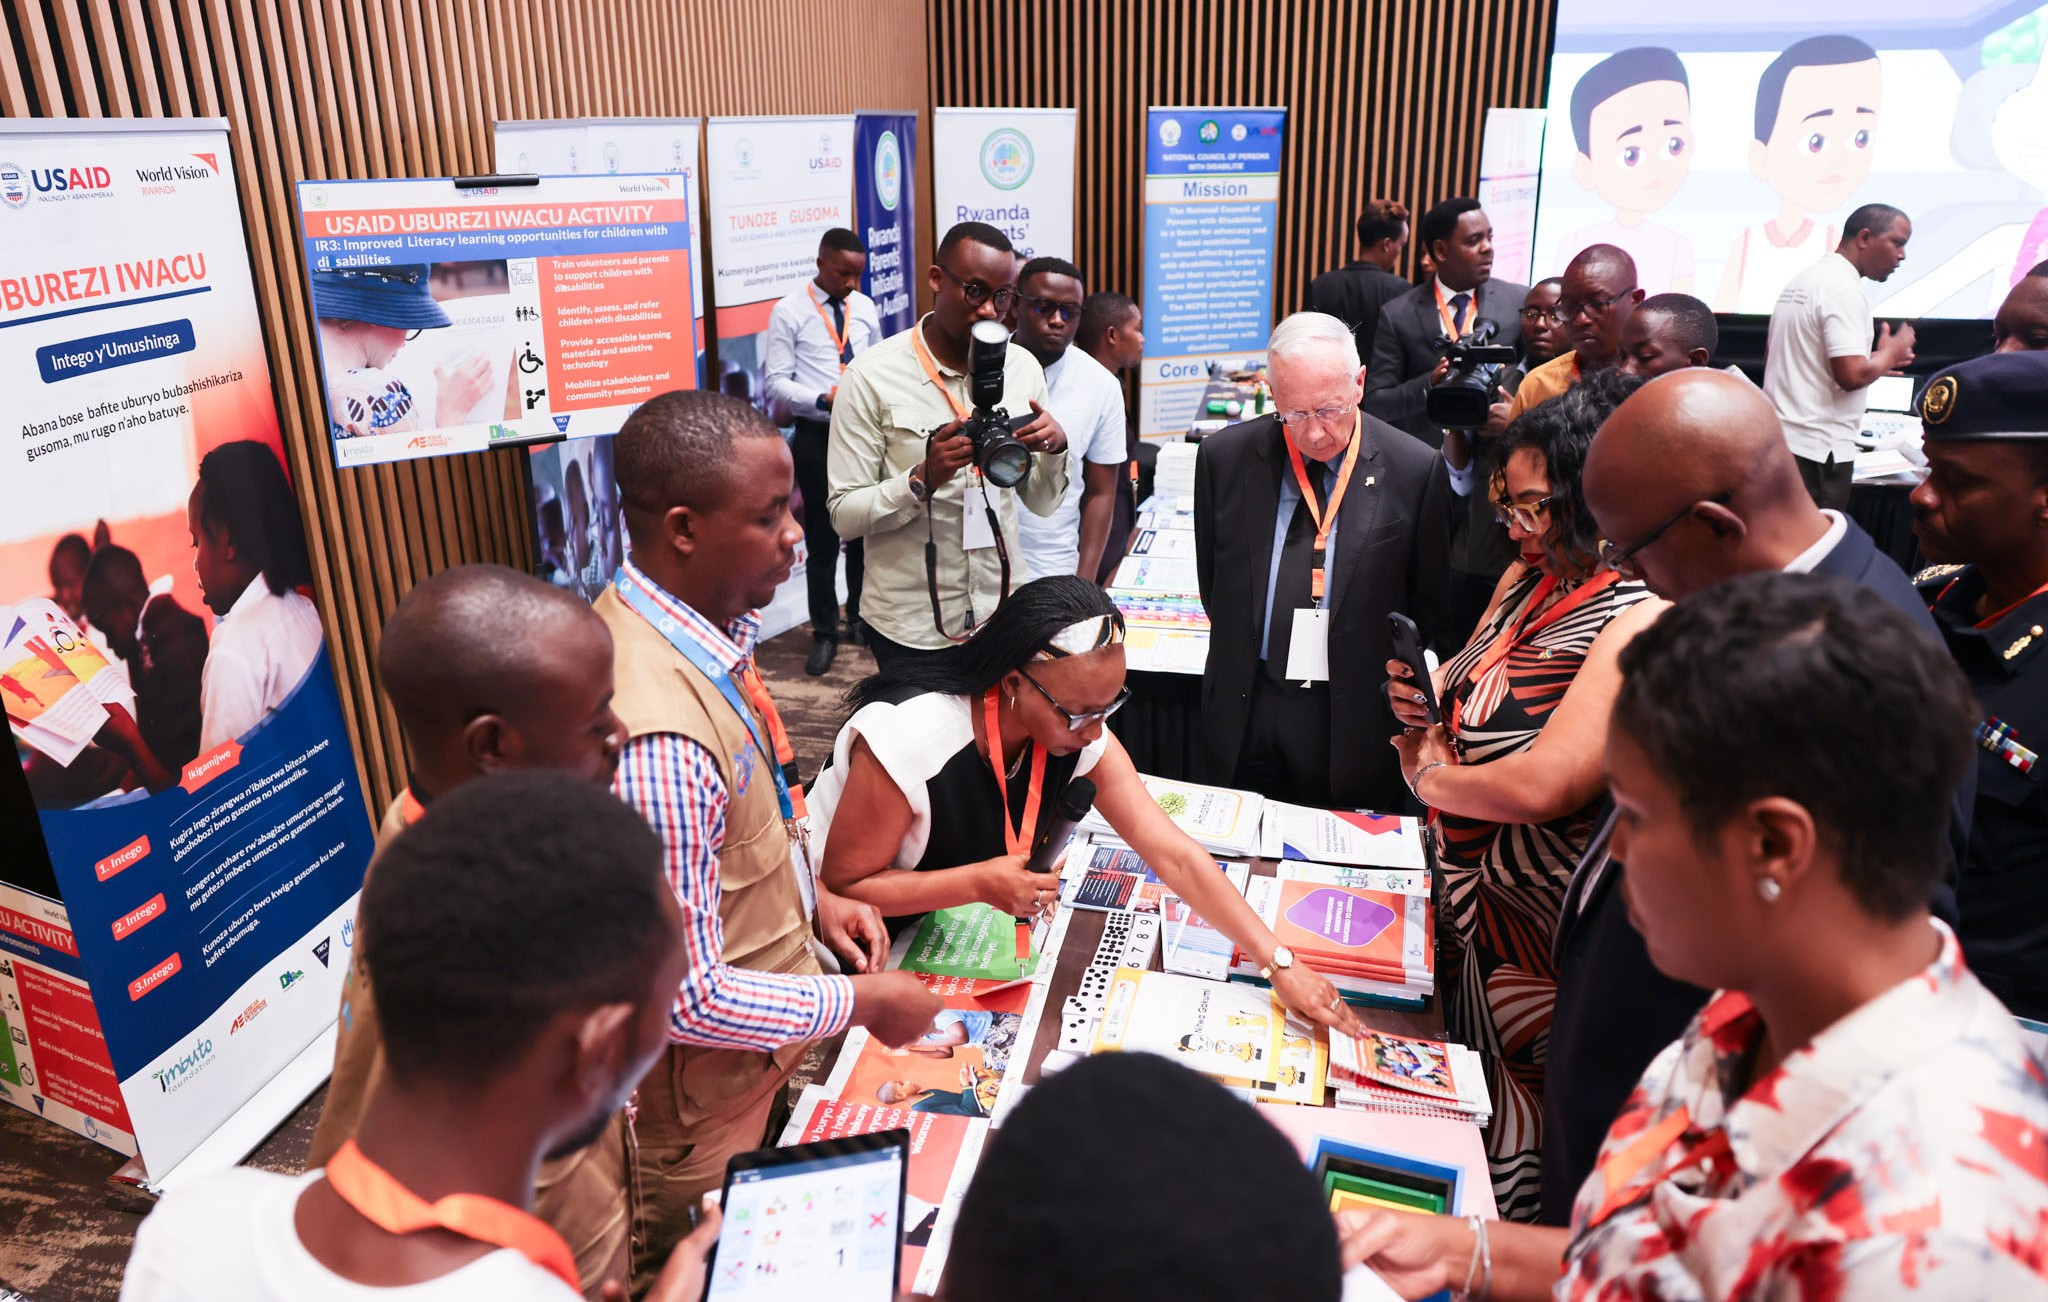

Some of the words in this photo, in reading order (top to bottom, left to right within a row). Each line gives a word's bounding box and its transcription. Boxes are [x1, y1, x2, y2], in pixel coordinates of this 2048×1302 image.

[136, 166, 173, 183] World
[174, 165, 209, 180] Vision
[808, 156, 842, 171] USAID
[31, 166, 111, 192] USAID
[141, 186, 177, 196] RWANDA
[619, 184, 640, 193] World
[642, 184, 663, 192] Vision
[1183, 181, 1248, 198] Mission
[471, 188, 498, 196] USAID
[324, 214, 395, 235] USAID
[399, 211, 490, 232] UBUREZI
[494, 206, 563, 229] IWACU
[567, 205, 655, 226] ACTIVITY
[729, 211, 778, 230] TUNOZE
[790, 206, 841, 224] GUSOMA
[956, 204, 1030, 221] Rwanda
[315, 239, 341, 252] IR3:
[344, 236, 402, 251] Improved
[407, 234, 456, 249] Literacy
[458, 232, 505, 246] learning
[507, 228, 582, 245] opportunities
[583, 227, 599, 239] for
[601, 225, 643, 238] children
[645, 225, 668, 236] with
[552, 260, 574, 270] Train
[576, 258, 621, 267] volunteers
[622, 256, 637, 265] and
[638, 255, 669, 266] parents
[553, 272, 563, 281] to
[564, 270, 597, 281] support
[599, 267, 632, 278] children
[634, 266, 652, 276] with
[0, 266, 111, 311] BUREZI
[115, 252, 207, 293] IWACU
[558, 304, 593, 316] Identify,
[594, 303, 622, 313] assess,
[623, 301, 638, 311] and
[639, 300, 660, 309] refer
[559, 317, 593, 327] children
[595, 314, 613, 324] with
[51, 349, 94, 371] Intego
[95, 331, 180, 364] y'Umushinga
[560, 337, 593, 348] Provide
[596, 334, 638, 345] accessible
[639, 331, 671, 342] learning
[562, 348, 600, 359] materials
[602, 346, 617, 356] and
[619, 344, 653, 354] assistive
[562, 359, 609, 371] technology
[1160, 362, 1199, 378] Core
[602, 374, 653, 386] stakeholders
[655, 372, 670, 381] and
[22, 420, 58, 440] Abana
[59, 412, 85, 429] bose
[87, 401, 119, 420] bafite
[121, 392, 161, 411] uburyo
[162, 369, 243, 400] bubashishikariza
[566, 389, 613, 402] community
[614, 385, 651, 396] members
[26, 438, 73, 462] gusoma,
[73, 430, 90, 446] mu
[91, 422, 117, 440] rugo
[118, 414, 147, 432] n'aho
[148, 404, 189, 425] batuye.
[188, 749, 231, 782] Ikigamijwe
[169, 827, 194, 850] Kugira
[192, 814, 210, 830] ingo
[210, 791, 246, 820] zirangwa
[284, 755, 307, 773] biteza
[305, 738, 329, 759] imbere
[173, 826, 214, 863] ubushobozi
[213, 814, 231, 832] bwo
[231, 797, 262, 822] gusoma
[262, 789, 272, 801] no
[185, 869, 216, 900] Kongera
[214, 849, 245, 875] uruhare
[285, 797, 324, 827] umuryango
[324, 778, 345, 801] mugari
[99, 862, 111, 875] 1.
[110, 843, 143, 870] Intego
[189, 898, 202, 912] mu
[200, 878, 225, 903] guteza
[223, 858, 252, 882] imbere
[251, 841, 278, 863] umuco
[277, 834, 290, 846] wo
[290, 814, 317, 839] gusoma
[316, 805, 328, 819] mu
[202, 928, 229, 956] Kunoza
[228, 908, 254, 933] uburyo
[253, 895, 271, 913] bwo
[270, 878, 294, 901] kwiga
[293, 858, 321, 886] gusoma
[319, 850, 330, 864] ku
[328, 841, 345, 858] bana
[114, 920, 127, 934] 2.
[125, 901, 158, 928] Intego
[13, 915, 73, 950] ACTIVITY
[205, 946, 227, 969] bafite
[225, 917, 261, 950] ubumuga.
[972, 913, 993, 951] amagambo
[1127, 961, 1140, 969] 6
[167, 1052, 217, 1095] foundation
